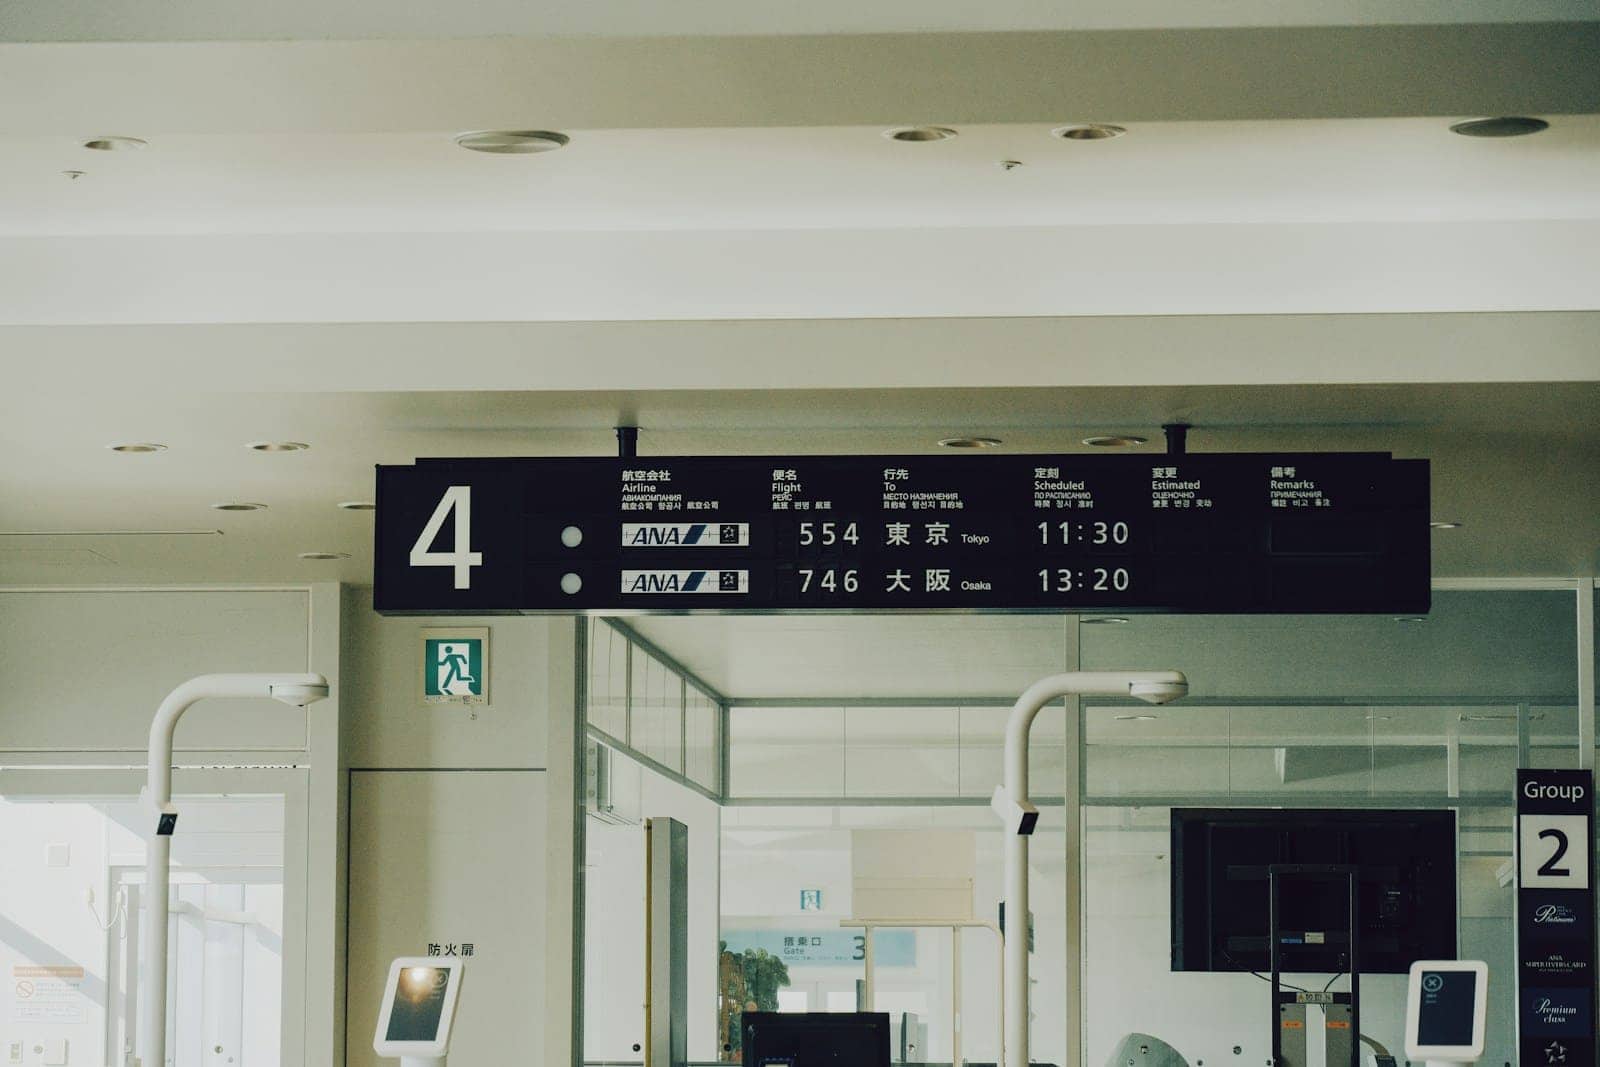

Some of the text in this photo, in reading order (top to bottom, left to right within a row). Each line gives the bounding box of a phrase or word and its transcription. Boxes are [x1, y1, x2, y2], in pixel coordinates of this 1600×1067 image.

[622, 470, 671, 481] 航空会社
[773, 469, 797, 480] 便名
[884, 469, 909, 480] 行先
[1034, 467, 1059, 479] 定刻
[1152, 467, 1177, 478] 変更
[1271, 467, 1296, 478] 備考
[622, 483, 656, 492] Airline
[772, 482, 802, 493] Flight
[884, 482, 896, 491] To
[1034, 481, 1084, 490] Scheduled
[1152, 480, 1200, 489] Estimated
[1270, 480, 1314, 489] Remarks
[410, 486, 482, 589] 4
[631, 522, 1128, 545] ANA 554 東京 Tokyo 11:30
[631, 568, 1129, 592] ANA 746 大阪 Osaka 13:20
[1524, 781, 1584, 803] Group
[1537, 829, 1570, 876] 2
[428, 943, 474, 956] 防火扉
[784, 936, 866, 960] 搭乗口 3
[1535, 998, 1577, 1014] Premium
[1544, 1014, 1566, 1023] class
